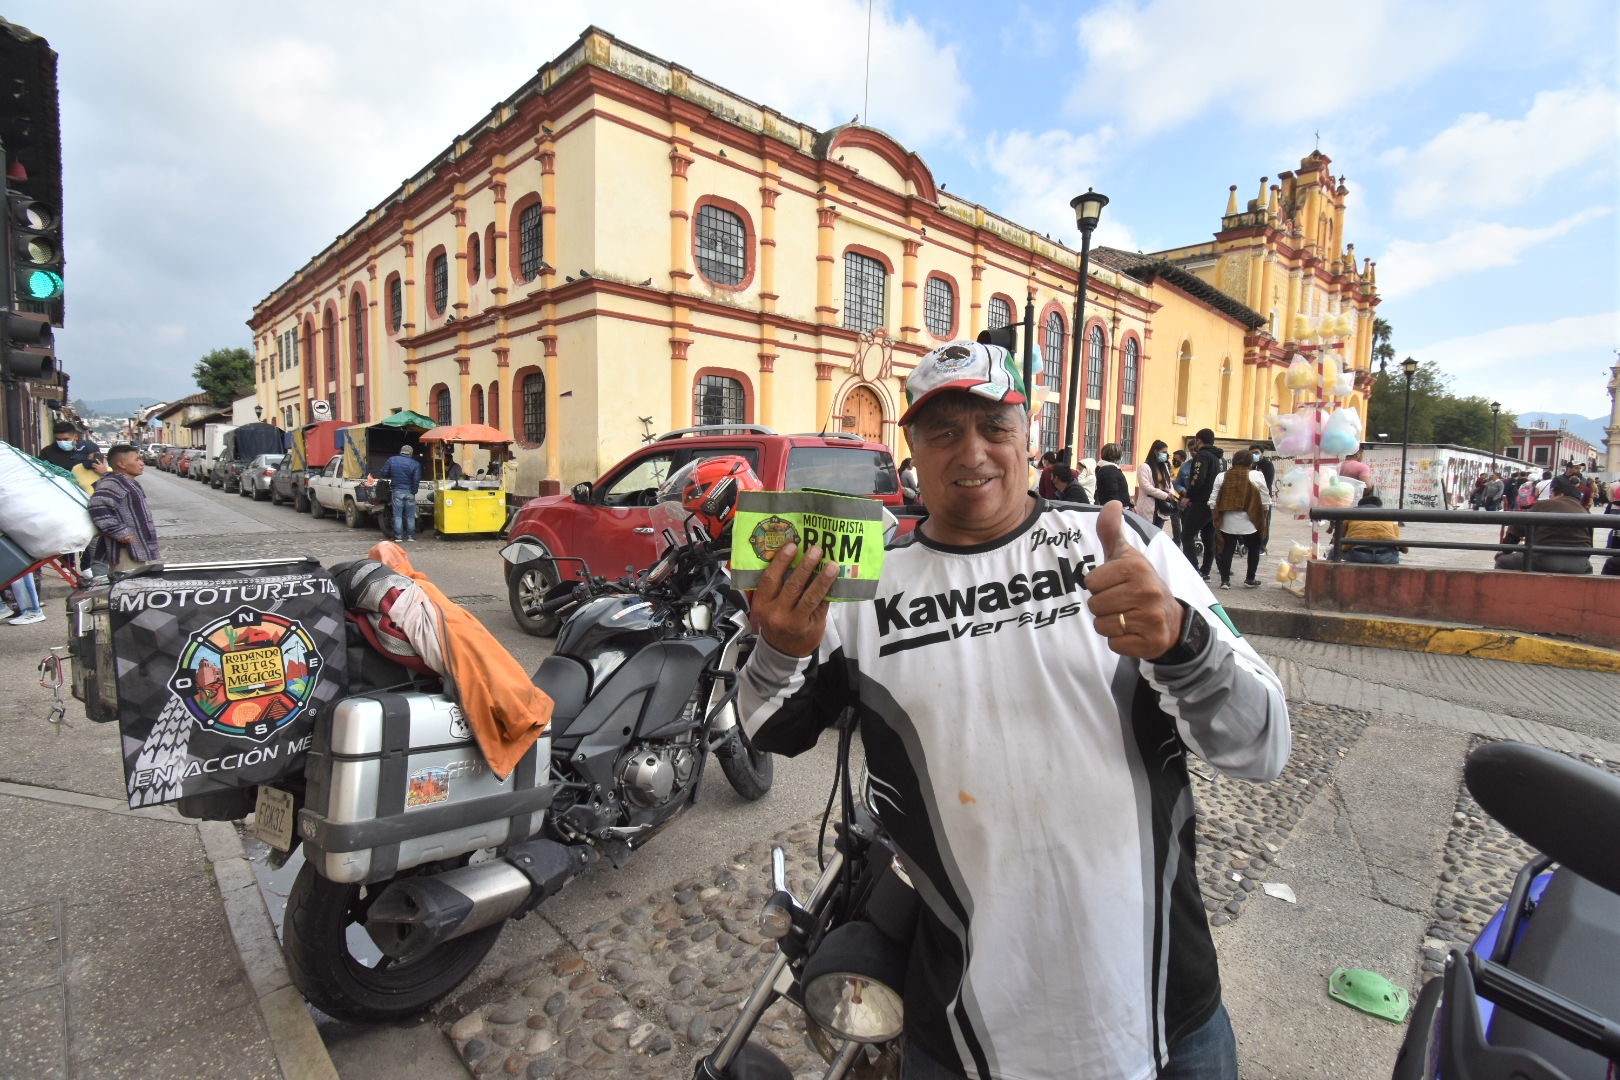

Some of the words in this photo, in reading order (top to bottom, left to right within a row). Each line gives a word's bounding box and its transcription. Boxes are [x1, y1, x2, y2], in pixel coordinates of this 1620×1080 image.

[804, 515, 864, 534] MOTOTURISTA
[119, 578, 336, 612] MOTOTURISTA
[238, 612, 254, 623] N
[309, 657, 319, 668] E
[254, 723, 268, 735] S
[135, 764, 175, 788] EN
[183, 744, 280, 779] ACCIÓN
